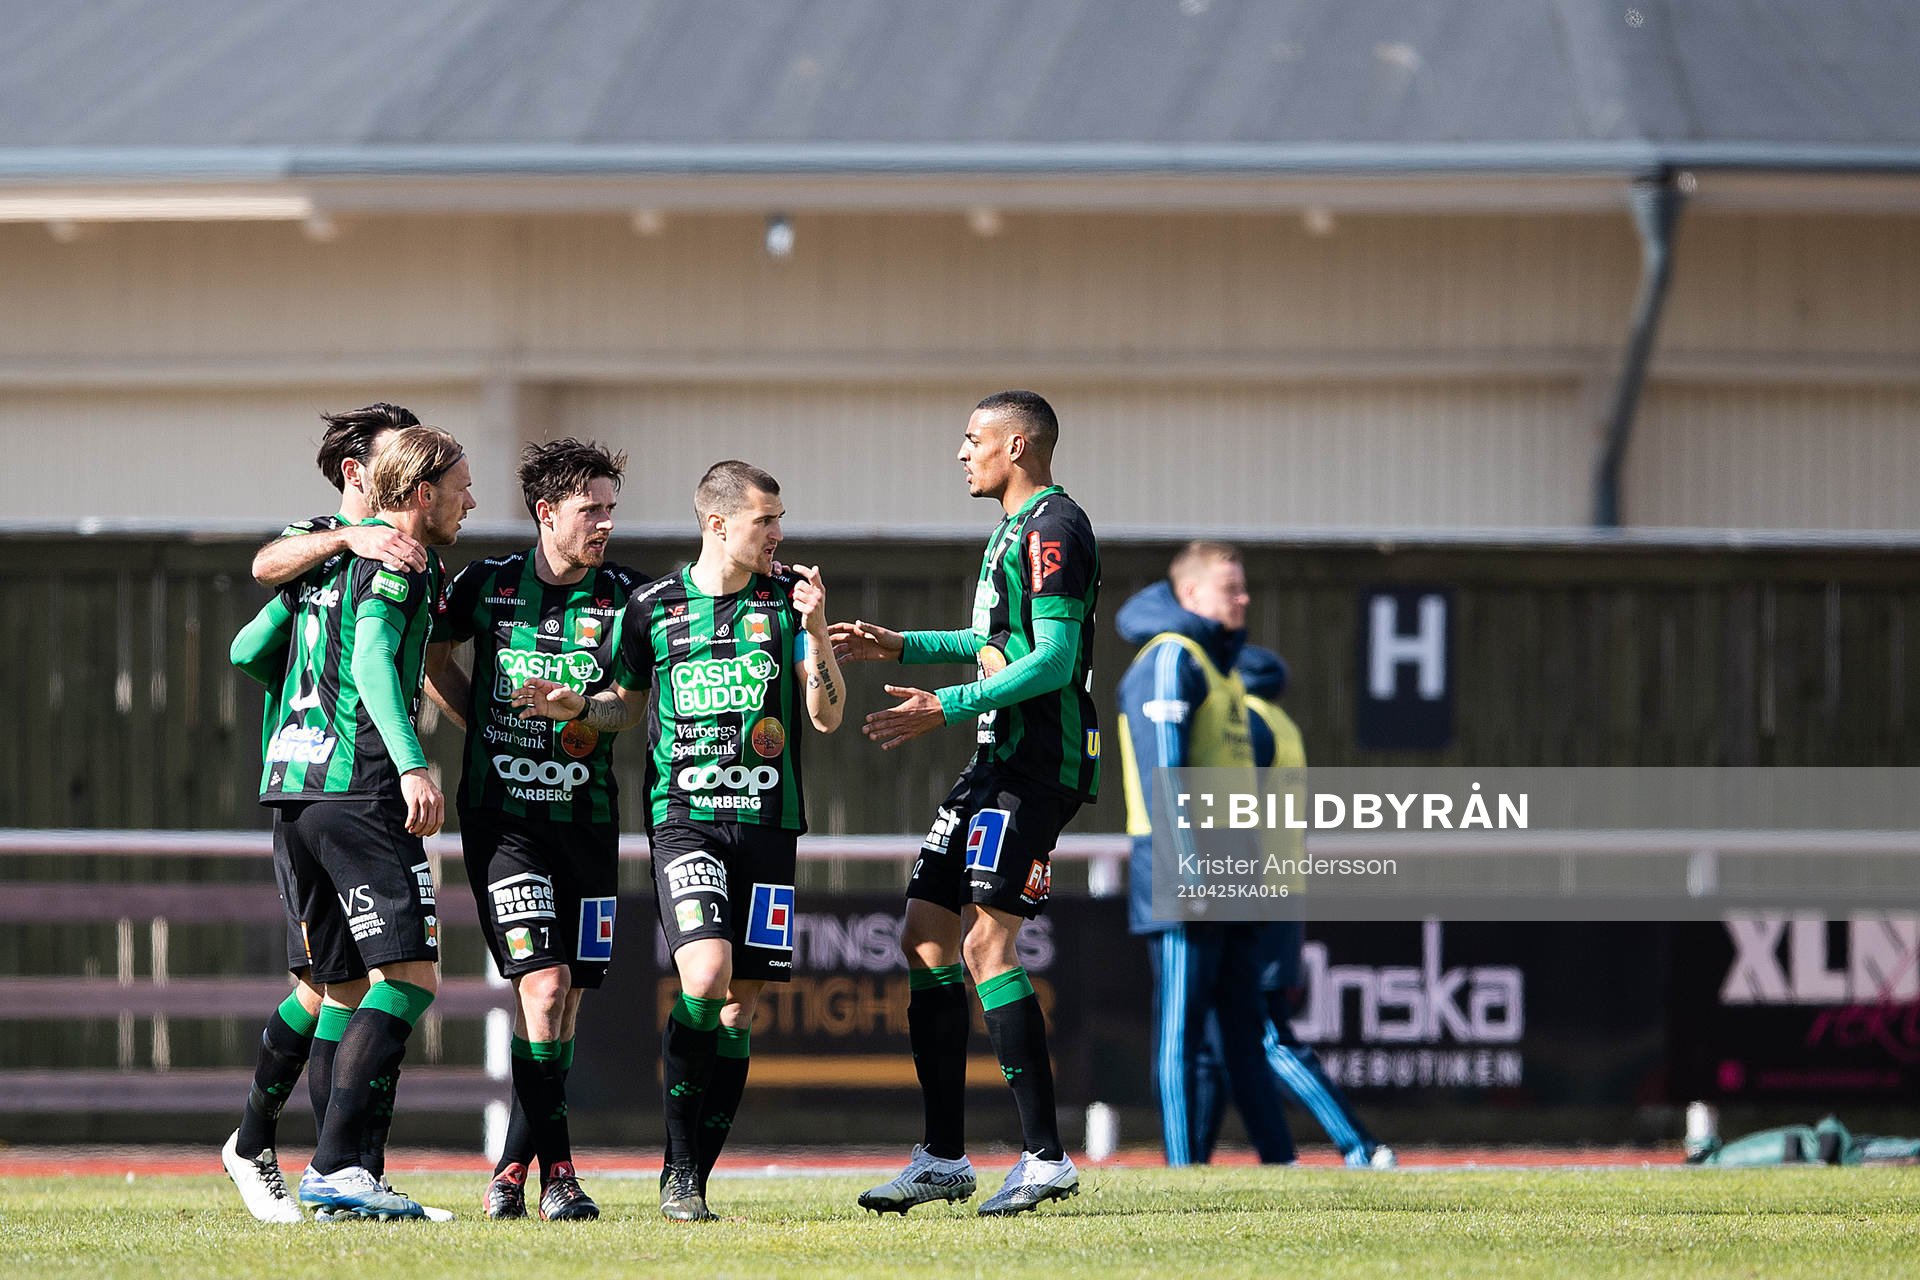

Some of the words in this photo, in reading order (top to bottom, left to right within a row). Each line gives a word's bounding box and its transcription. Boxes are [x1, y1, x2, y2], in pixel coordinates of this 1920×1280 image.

[1369, 595, 1446, 699] H
[499, 653, 564, 681] CASH
[676, 664, 742, 689] CASH
[679, 684, 763, 711] BUDDY
[490, 707, 547, 734] Varbergs
[676, 723, 737, 741] Varbergs
[483, 724, 547, 750] Sparbank
[671, 740, 737, 760] Sparbank
[492, 754, 590, 792] coop
[677, 764, 779, 796] coop
[506, 785, 573, 802] VARBERG
[690, 795, 762, 810] VARBERG
[337, 884, 375, 917] VS
[709, 902, 723, 923] 2
[540, 926, 549, 949] 7
[768, 960, 789, 969] CRAFT
